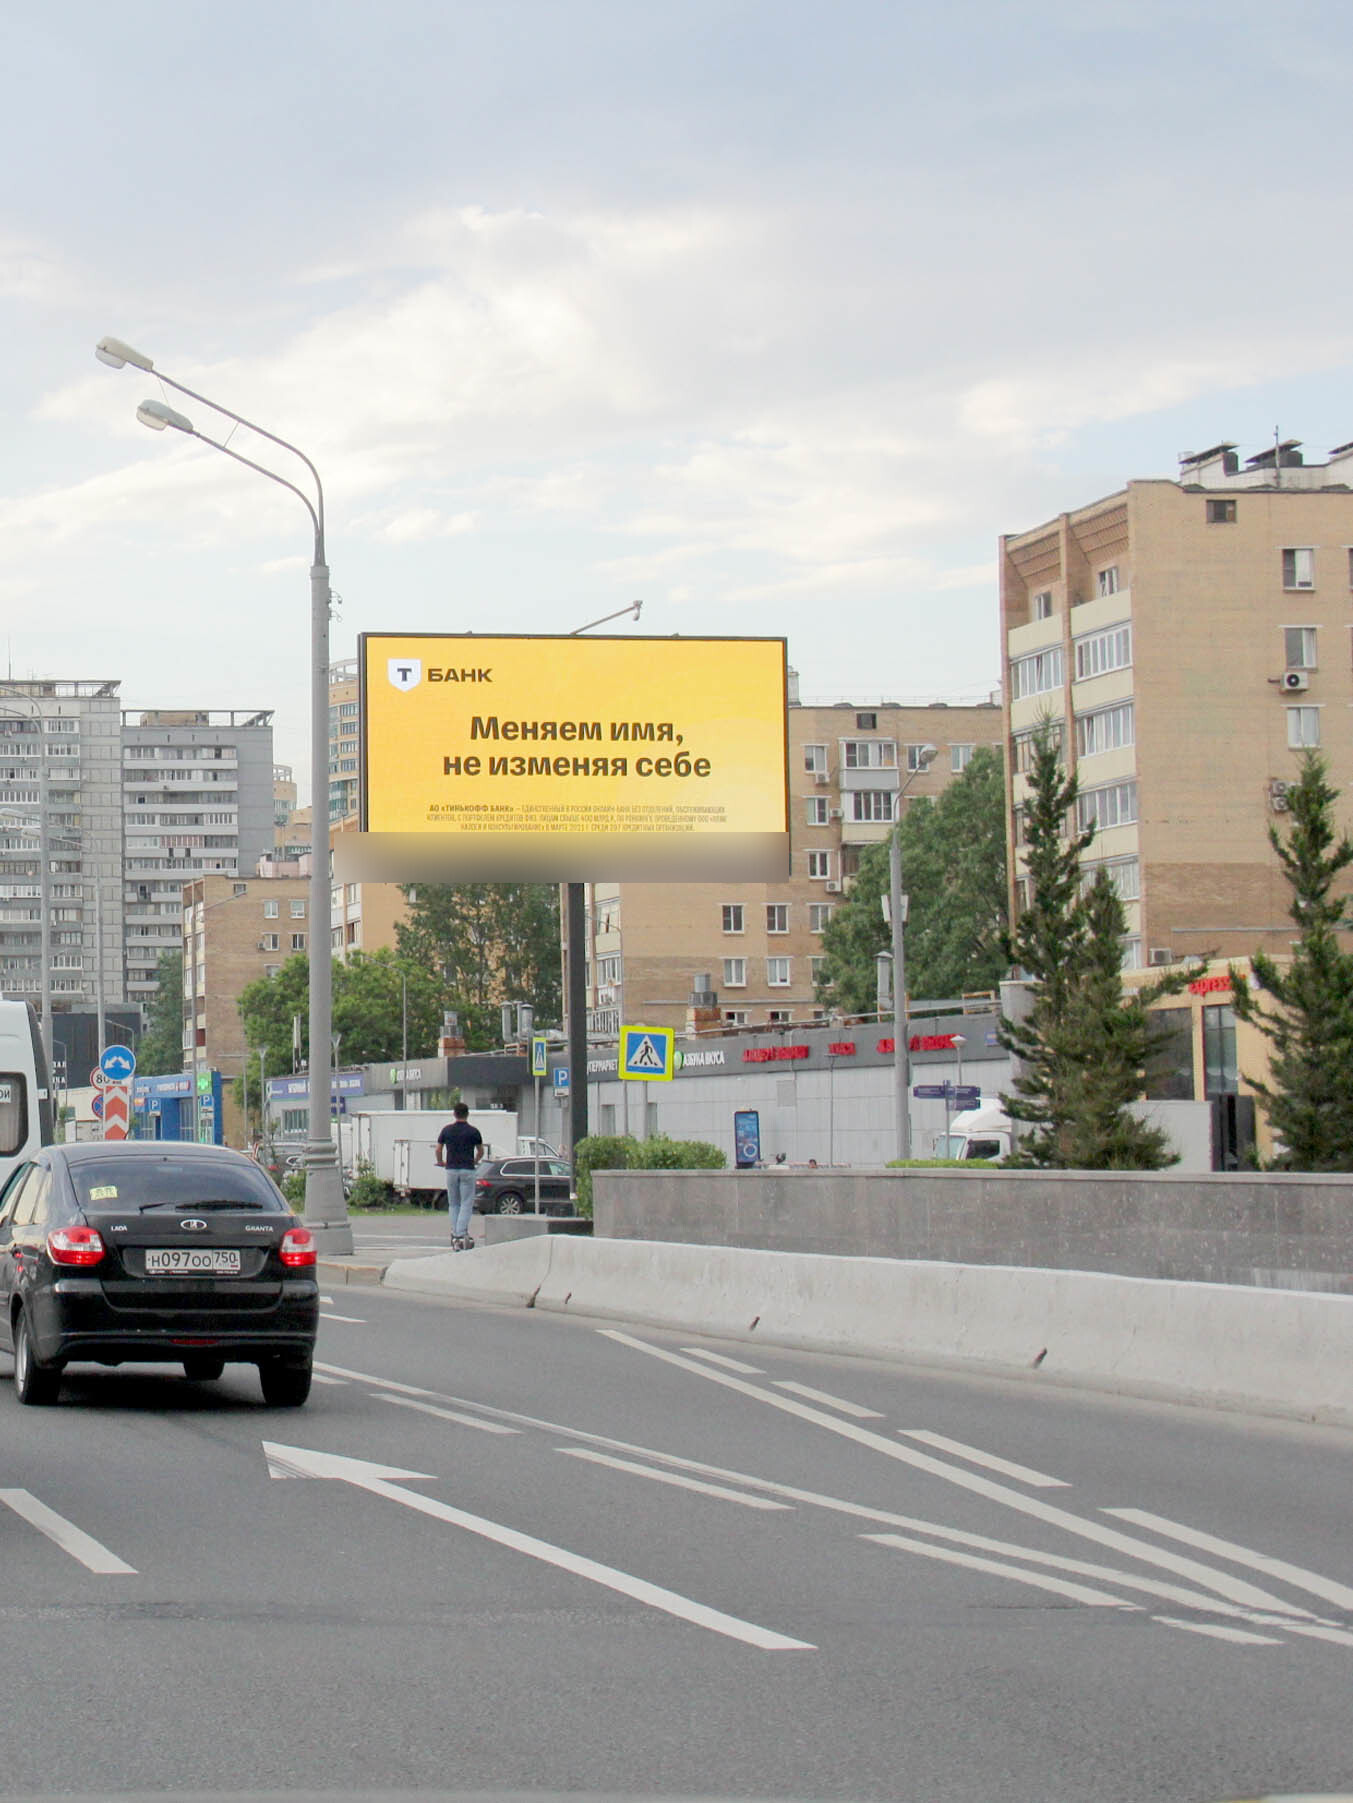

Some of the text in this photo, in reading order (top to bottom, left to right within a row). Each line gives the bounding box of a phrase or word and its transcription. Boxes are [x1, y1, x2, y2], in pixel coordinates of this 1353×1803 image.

[427, 668, 493, 683] БАНК
[470, 716, 684, 746] Меняем имя,
[443, 751, 711, 777] не изменяя себе
[151, 1251, 236, 1267] Н097ОО 750
